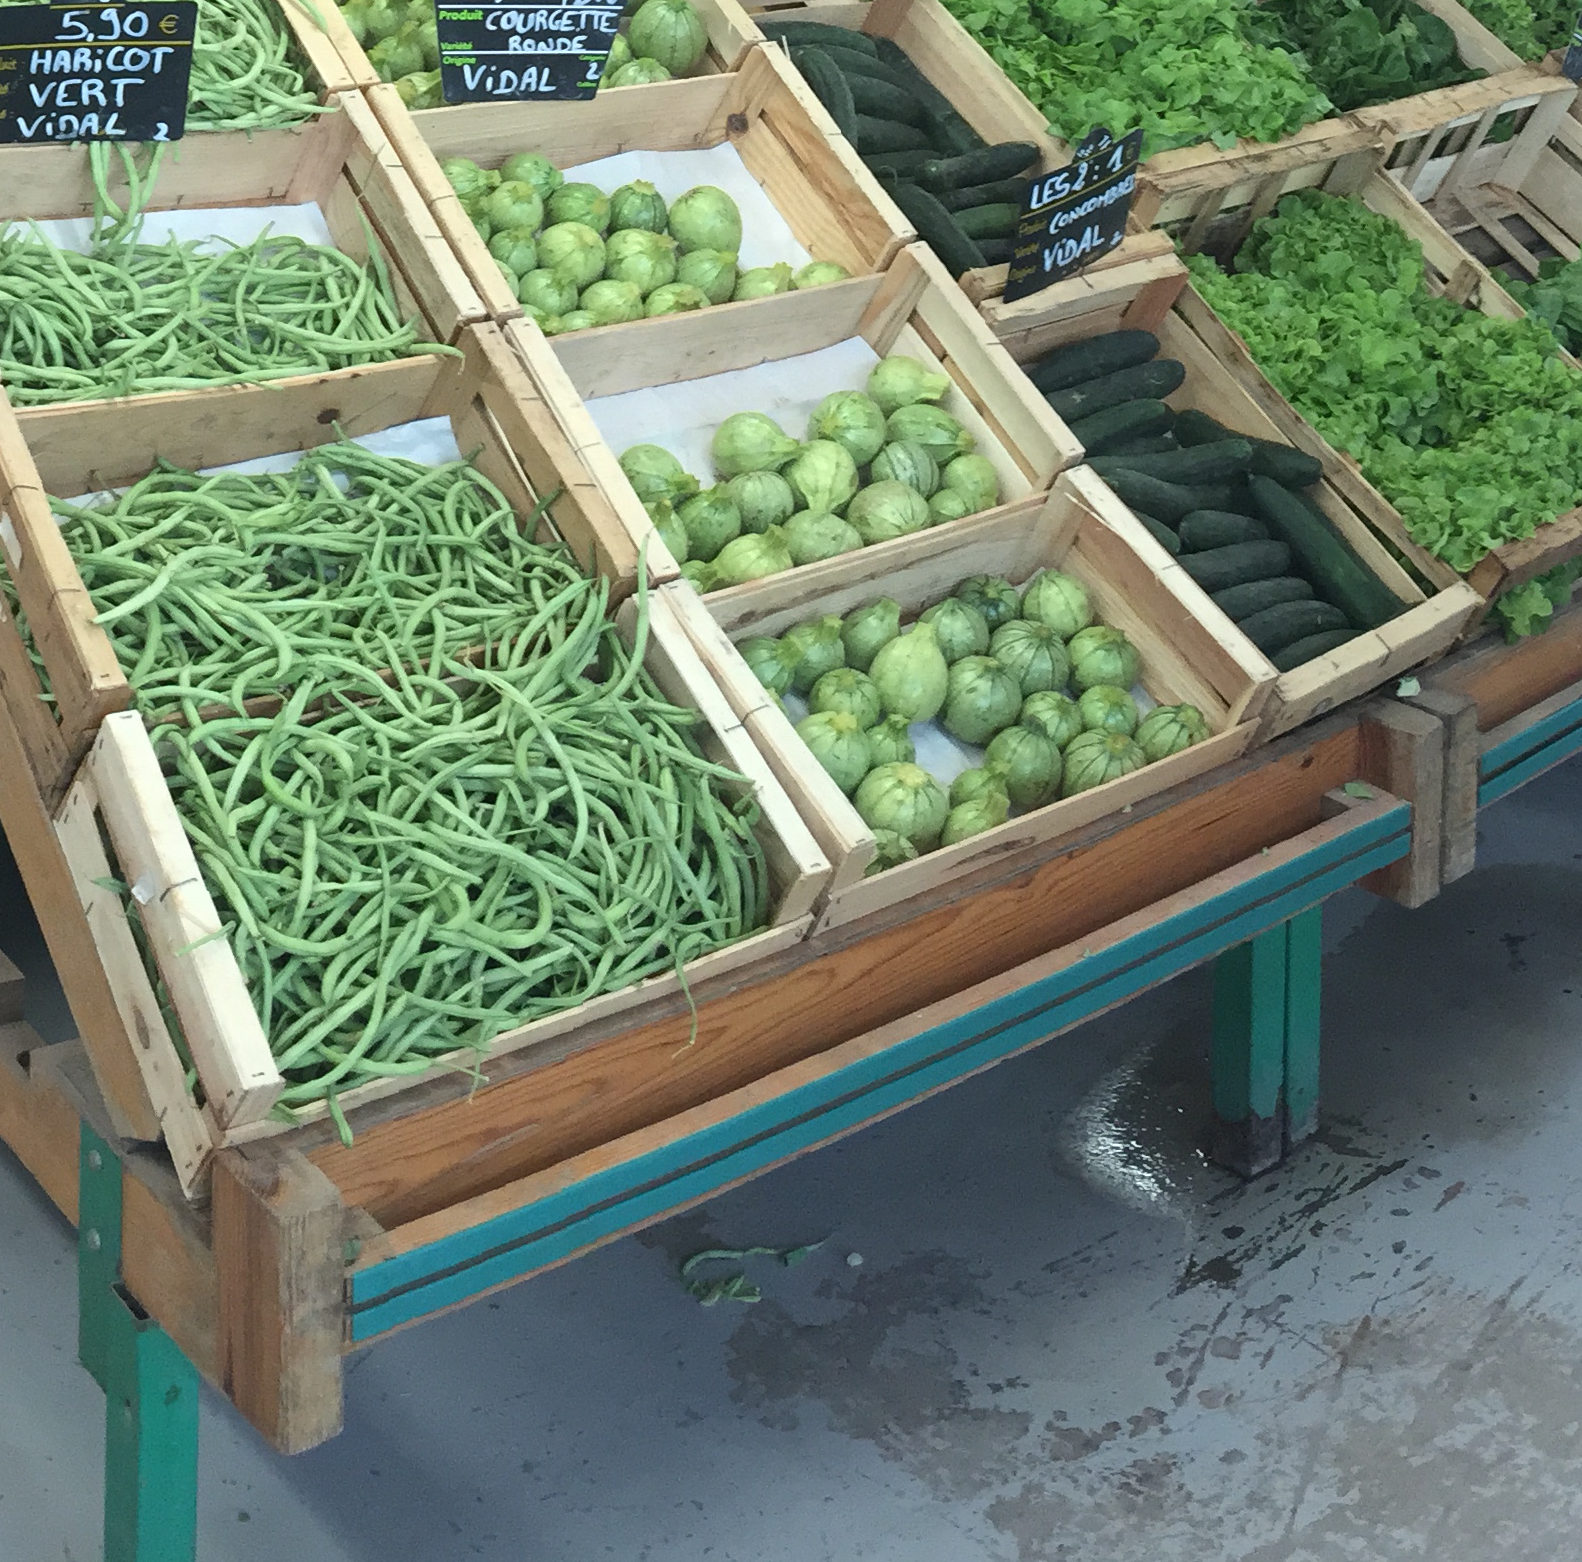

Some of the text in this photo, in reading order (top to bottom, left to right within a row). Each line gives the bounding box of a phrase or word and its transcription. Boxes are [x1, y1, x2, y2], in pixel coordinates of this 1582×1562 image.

[54, 7, 179, 42] 5,90 €
[438, 9, 619, 34] Produit COURGETTE
[440, 35, 588, 52] Variété RONDE
[442, 55, 477, 66] Origine
[463, 62, 600, 94] ViDAL 2
[28, 78, 146, 108] VERT
[152, 122, 170, 141] 2
[1030, 172, 1070, 209] LES
